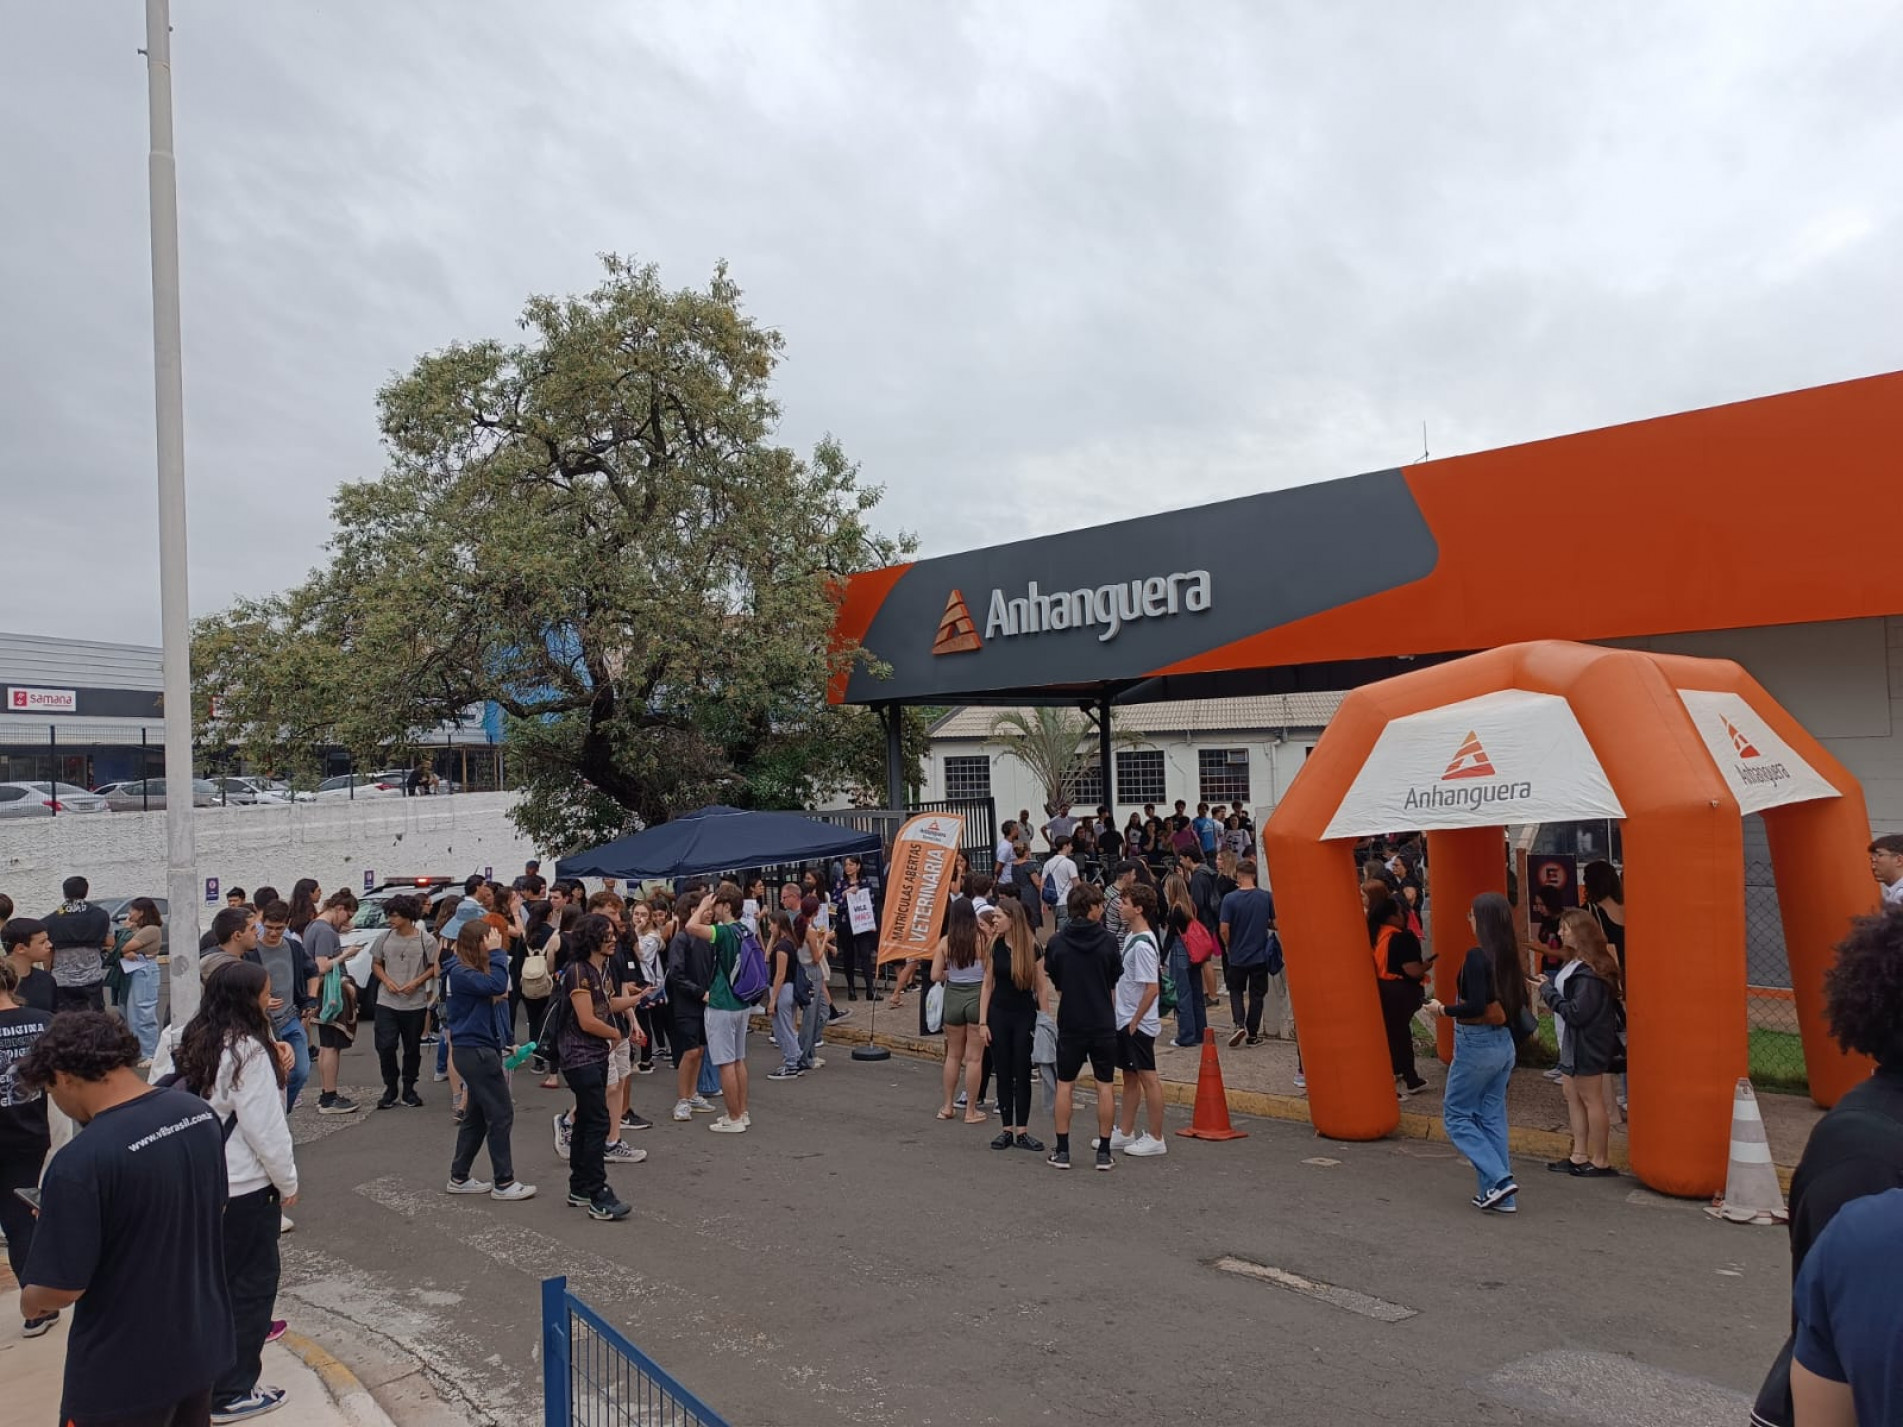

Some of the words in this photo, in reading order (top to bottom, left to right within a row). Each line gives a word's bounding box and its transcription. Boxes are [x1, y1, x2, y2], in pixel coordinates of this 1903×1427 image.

[985, 570, 1211, 642] Anhanguera
[30, 694, 72, 705] samana
[1734, 762, 1791, 788] Anhanguera
[1404, 781, 1532, 811] Anhanguera
[892, 885, 914, 942] MATRÍCULAS
[905, 843, 922, 885] ABERTAS
[908, 849, 945, 943] VETERINÁRIA
[0, 1024, 44, 1037] DICINA
